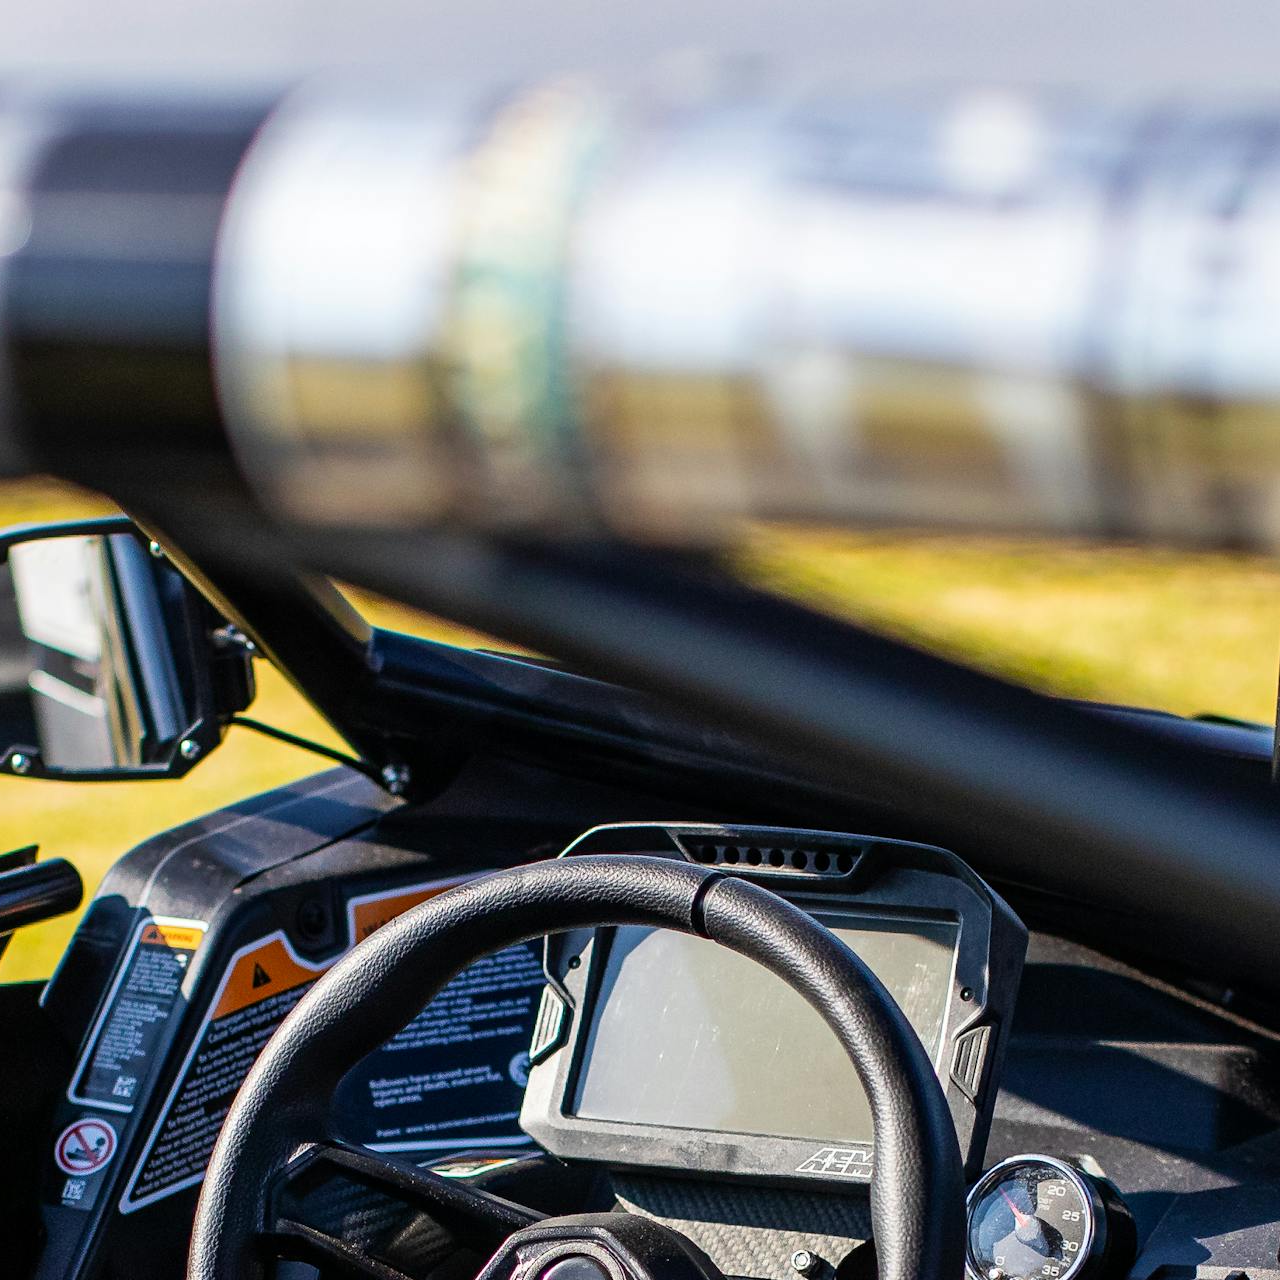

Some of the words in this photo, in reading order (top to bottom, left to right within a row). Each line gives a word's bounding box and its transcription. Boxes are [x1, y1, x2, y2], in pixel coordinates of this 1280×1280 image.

[1047, 1185, 1066, 1197] 20
[1062, 1210, 1080, 1222] 25
[1061, 1240, 1079, 1252] 30
[1042, 1265, 1060, 1277] 35
